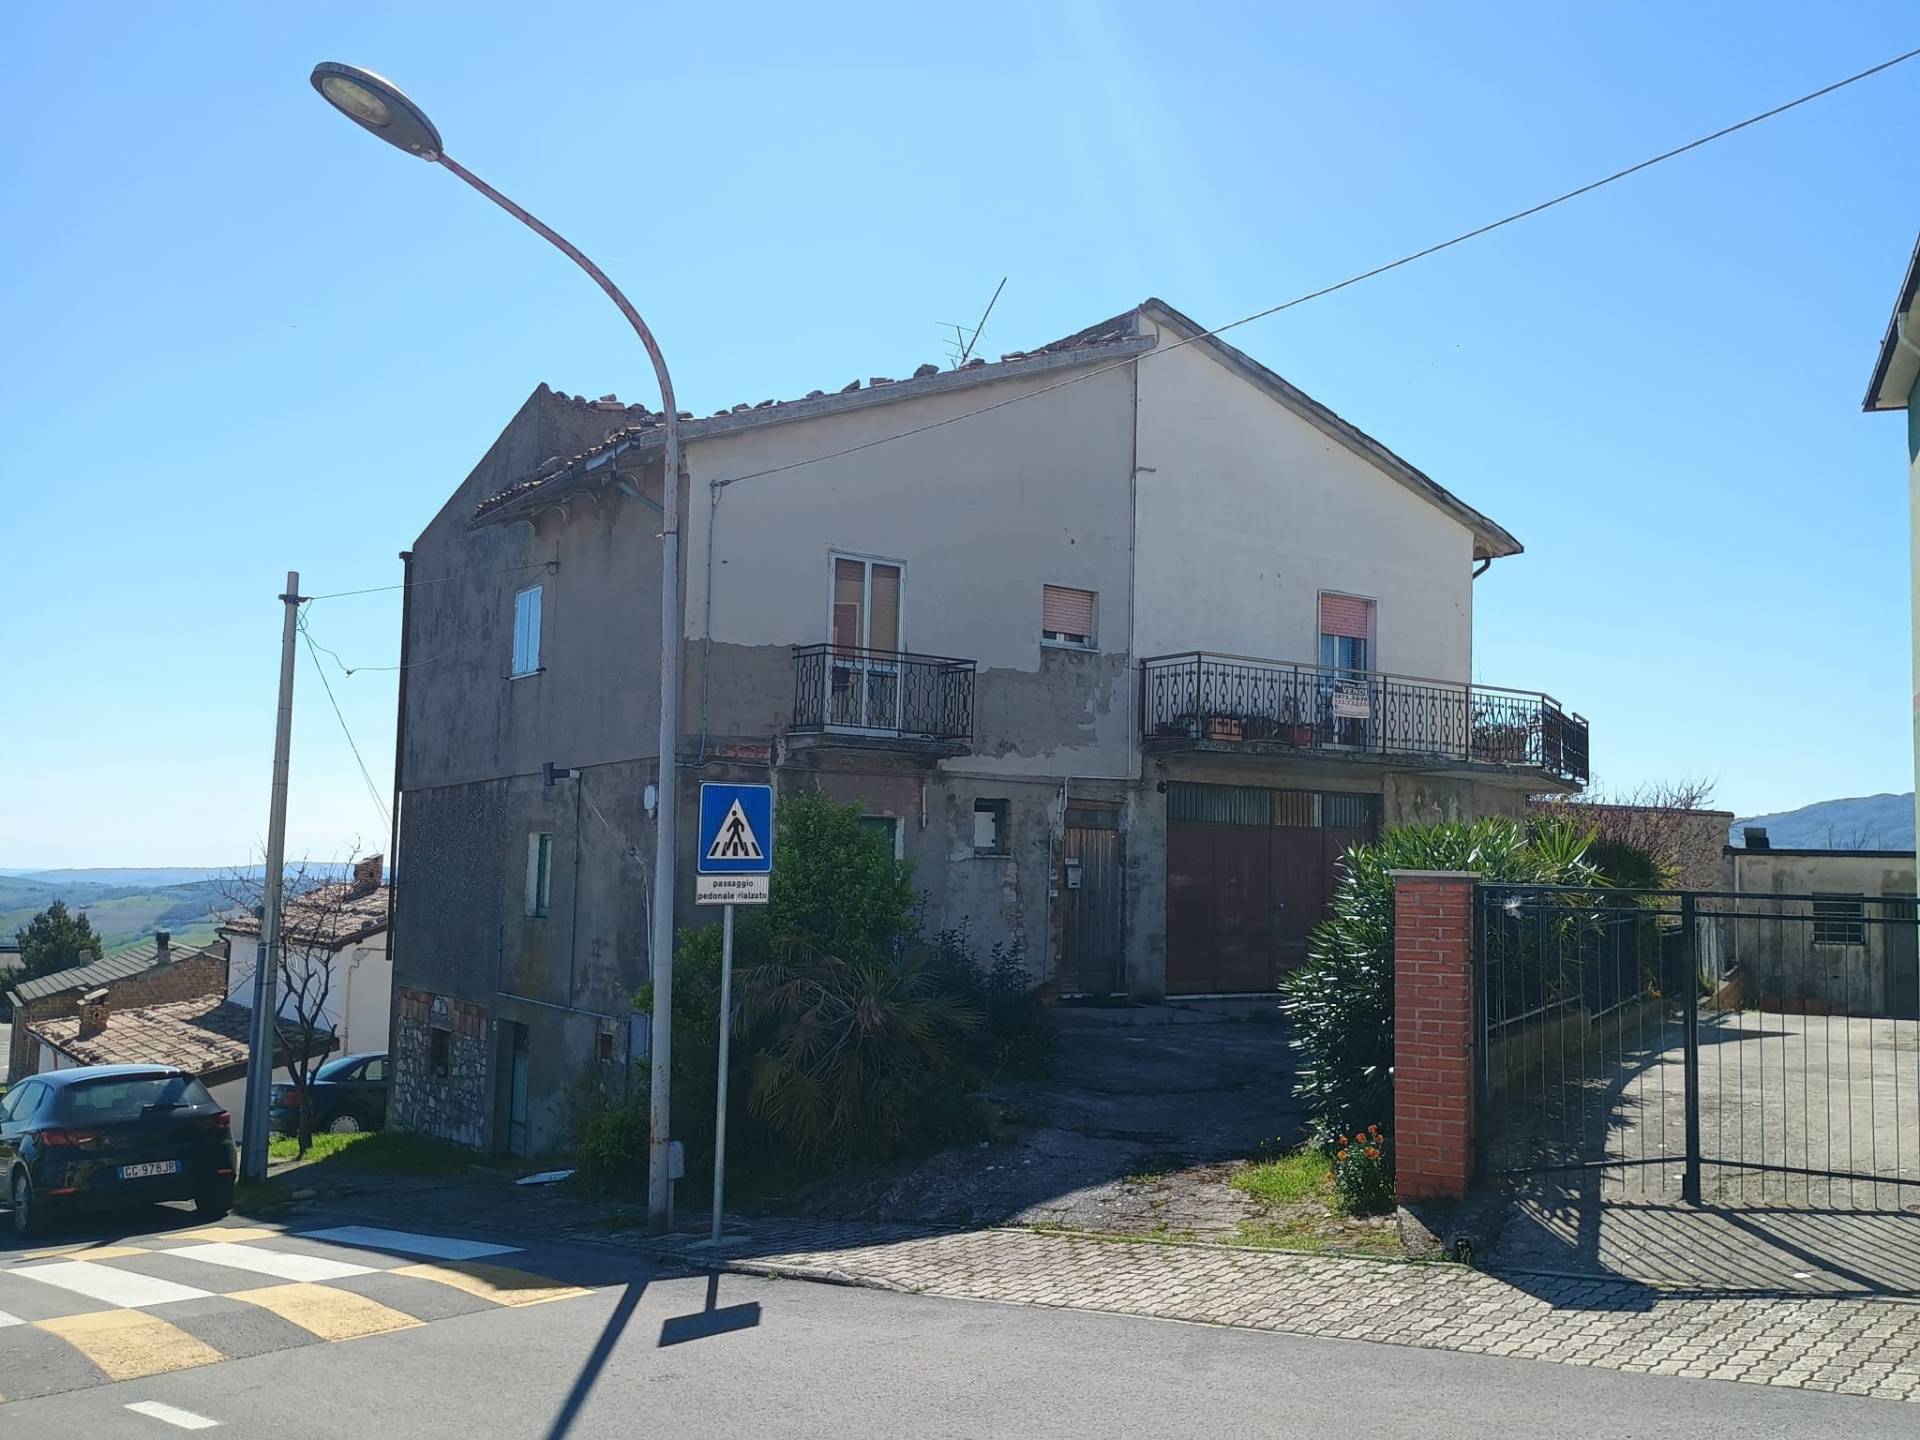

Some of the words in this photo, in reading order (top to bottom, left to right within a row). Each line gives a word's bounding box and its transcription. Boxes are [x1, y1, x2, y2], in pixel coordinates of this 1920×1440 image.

[712, 880, 754, 888] passaggio
[698, 891, 735, 900] pedonale
[737, 891, 768, 899] rialzato
